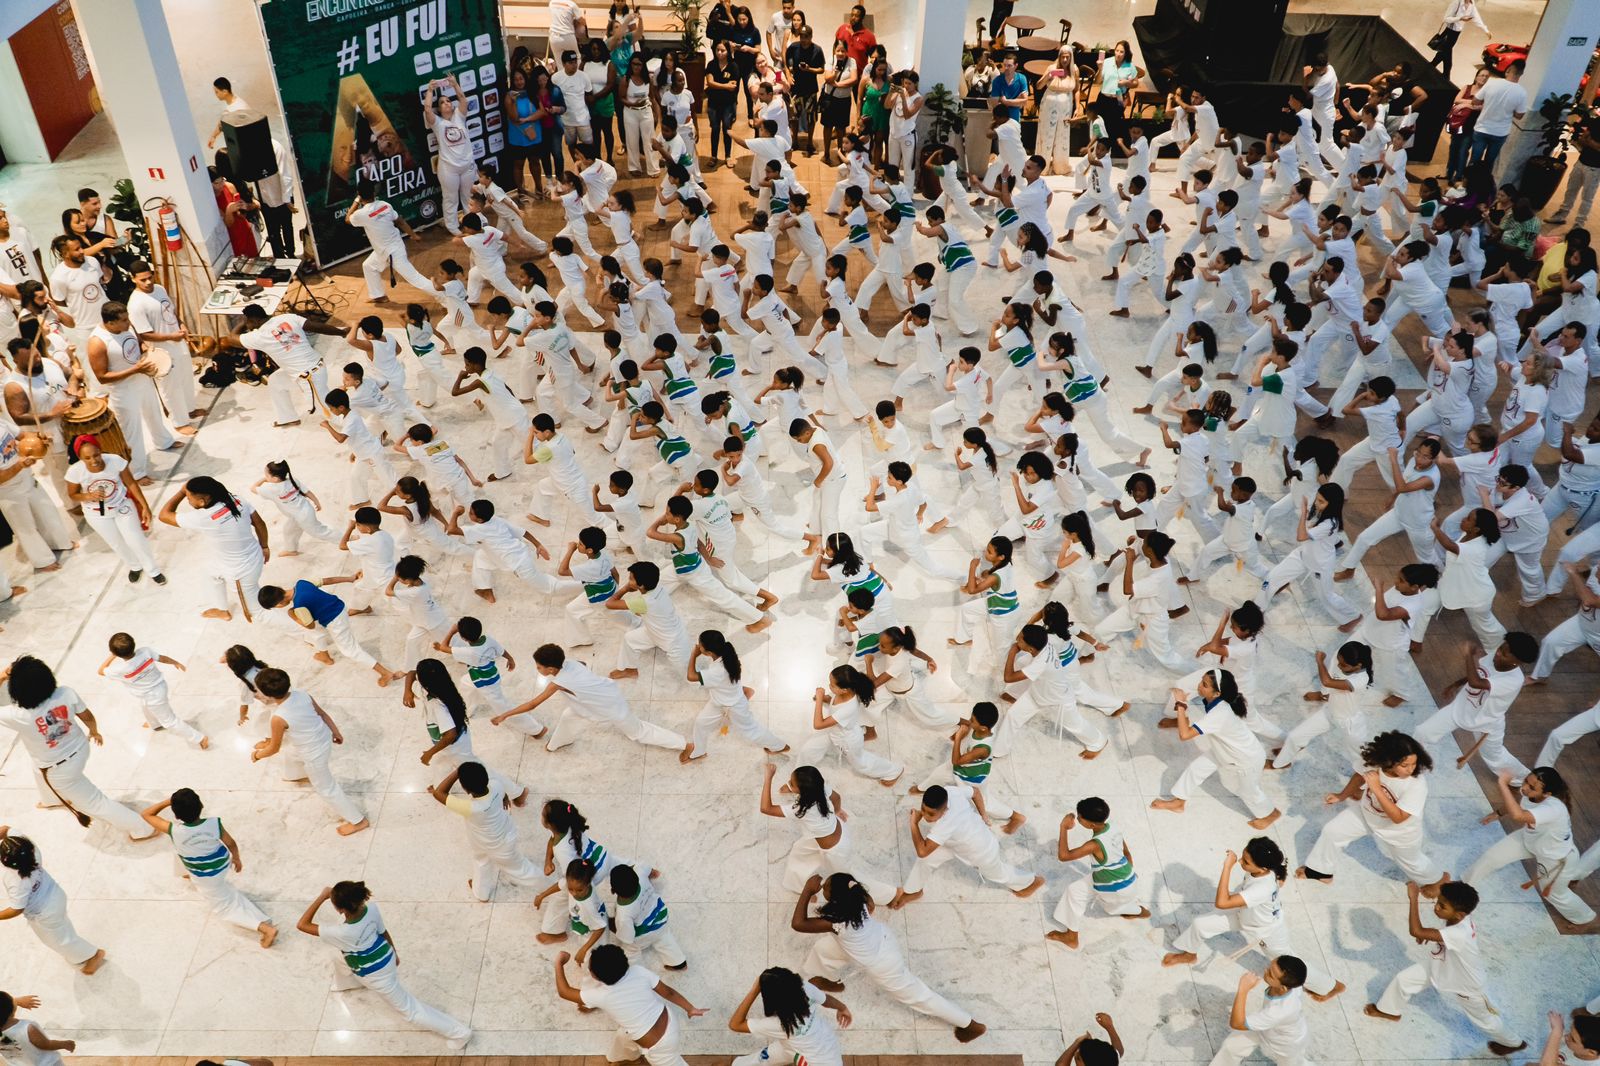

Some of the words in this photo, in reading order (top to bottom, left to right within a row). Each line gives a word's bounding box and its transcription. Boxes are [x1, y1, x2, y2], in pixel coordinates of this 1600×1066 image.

[337, 9, 368, 22] CAPOEIRA
[366, 16, 399, 65] EU
[406, 0, 447, 48] FUI
[355, 154, 402, 185] CAPO
[386, 167, 426, 199] EIRA
